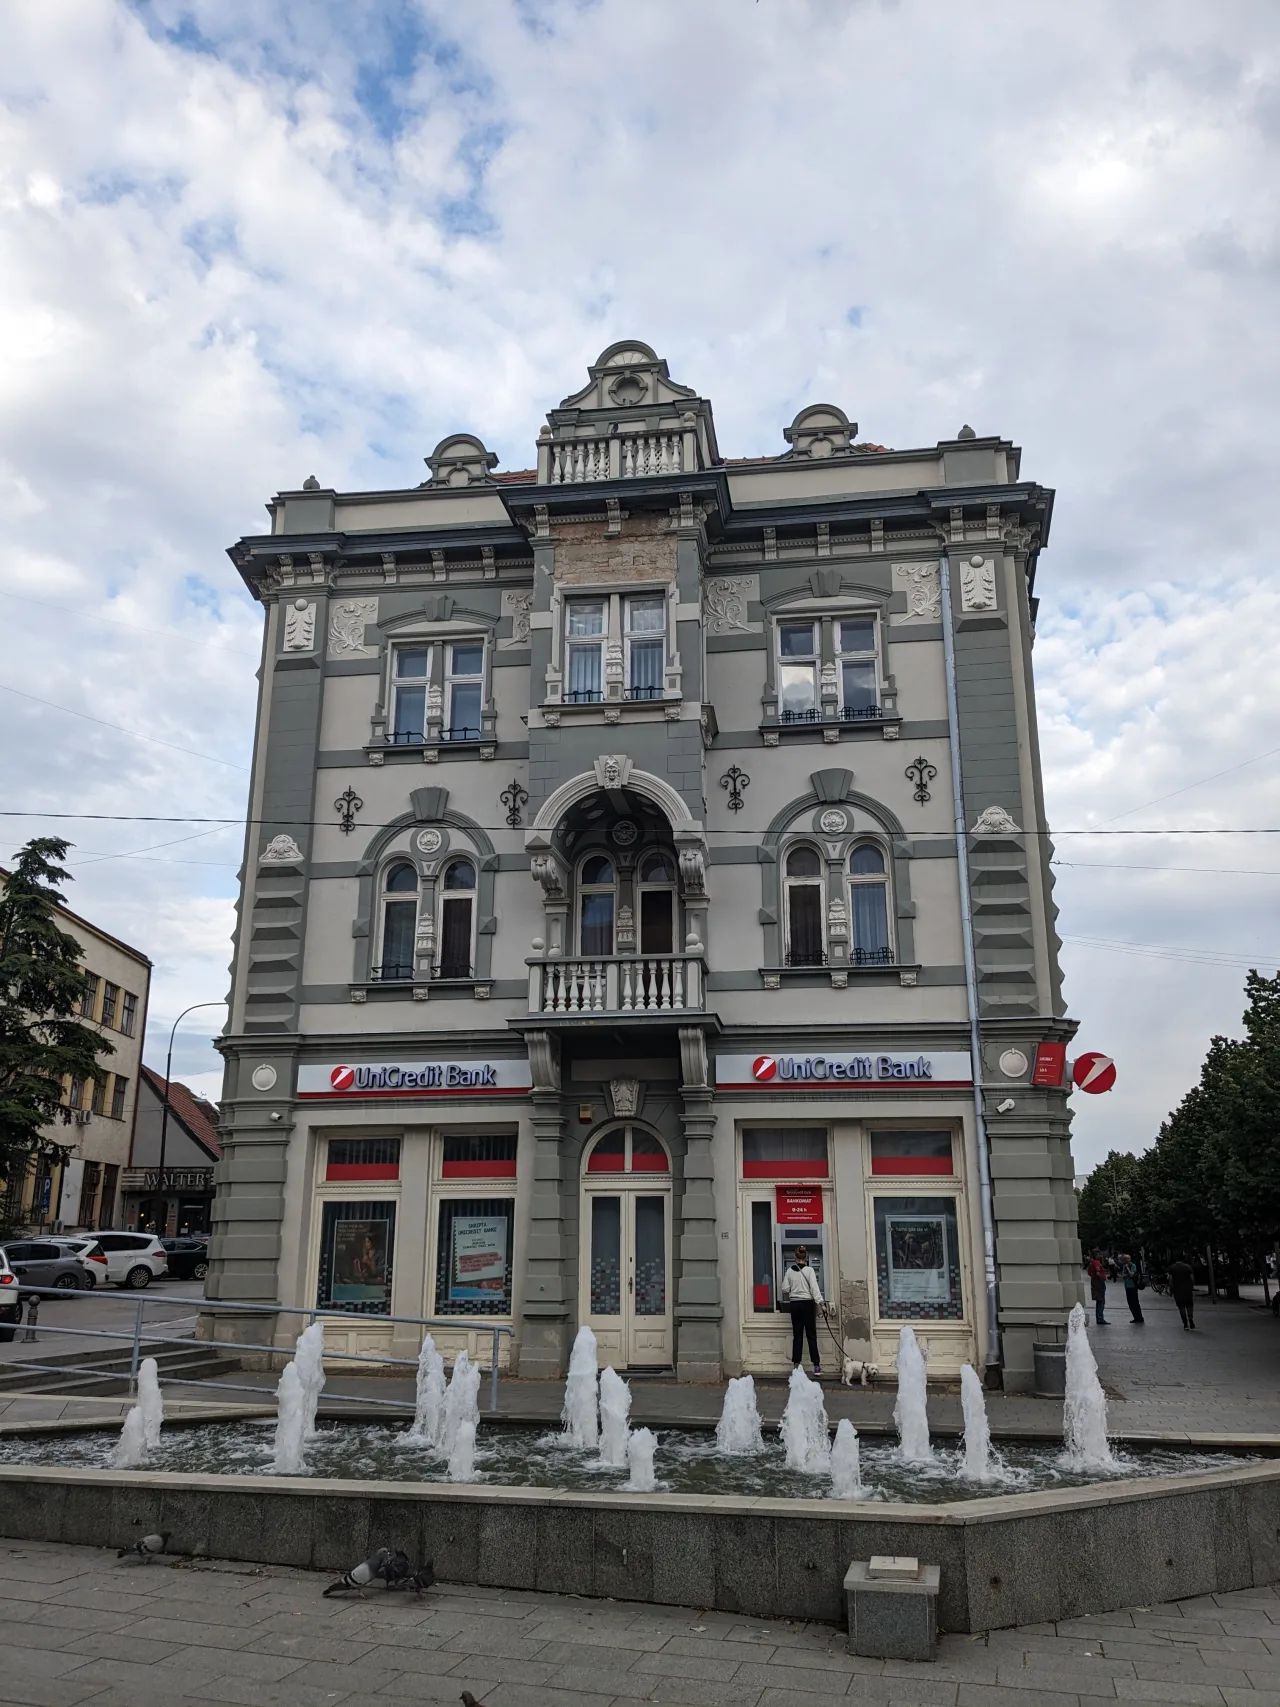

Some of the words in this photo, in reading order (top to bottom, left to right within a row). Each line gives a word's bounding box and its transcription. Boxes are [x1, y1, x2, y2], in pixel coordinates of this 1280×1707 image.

[355, 1065, 442, 1088] UniCredit
[446, 1064, 496, 1087] Bank
[778, 1056, 872, 1079] UniCredit
[877, 1056, 932, 1078] Bank
